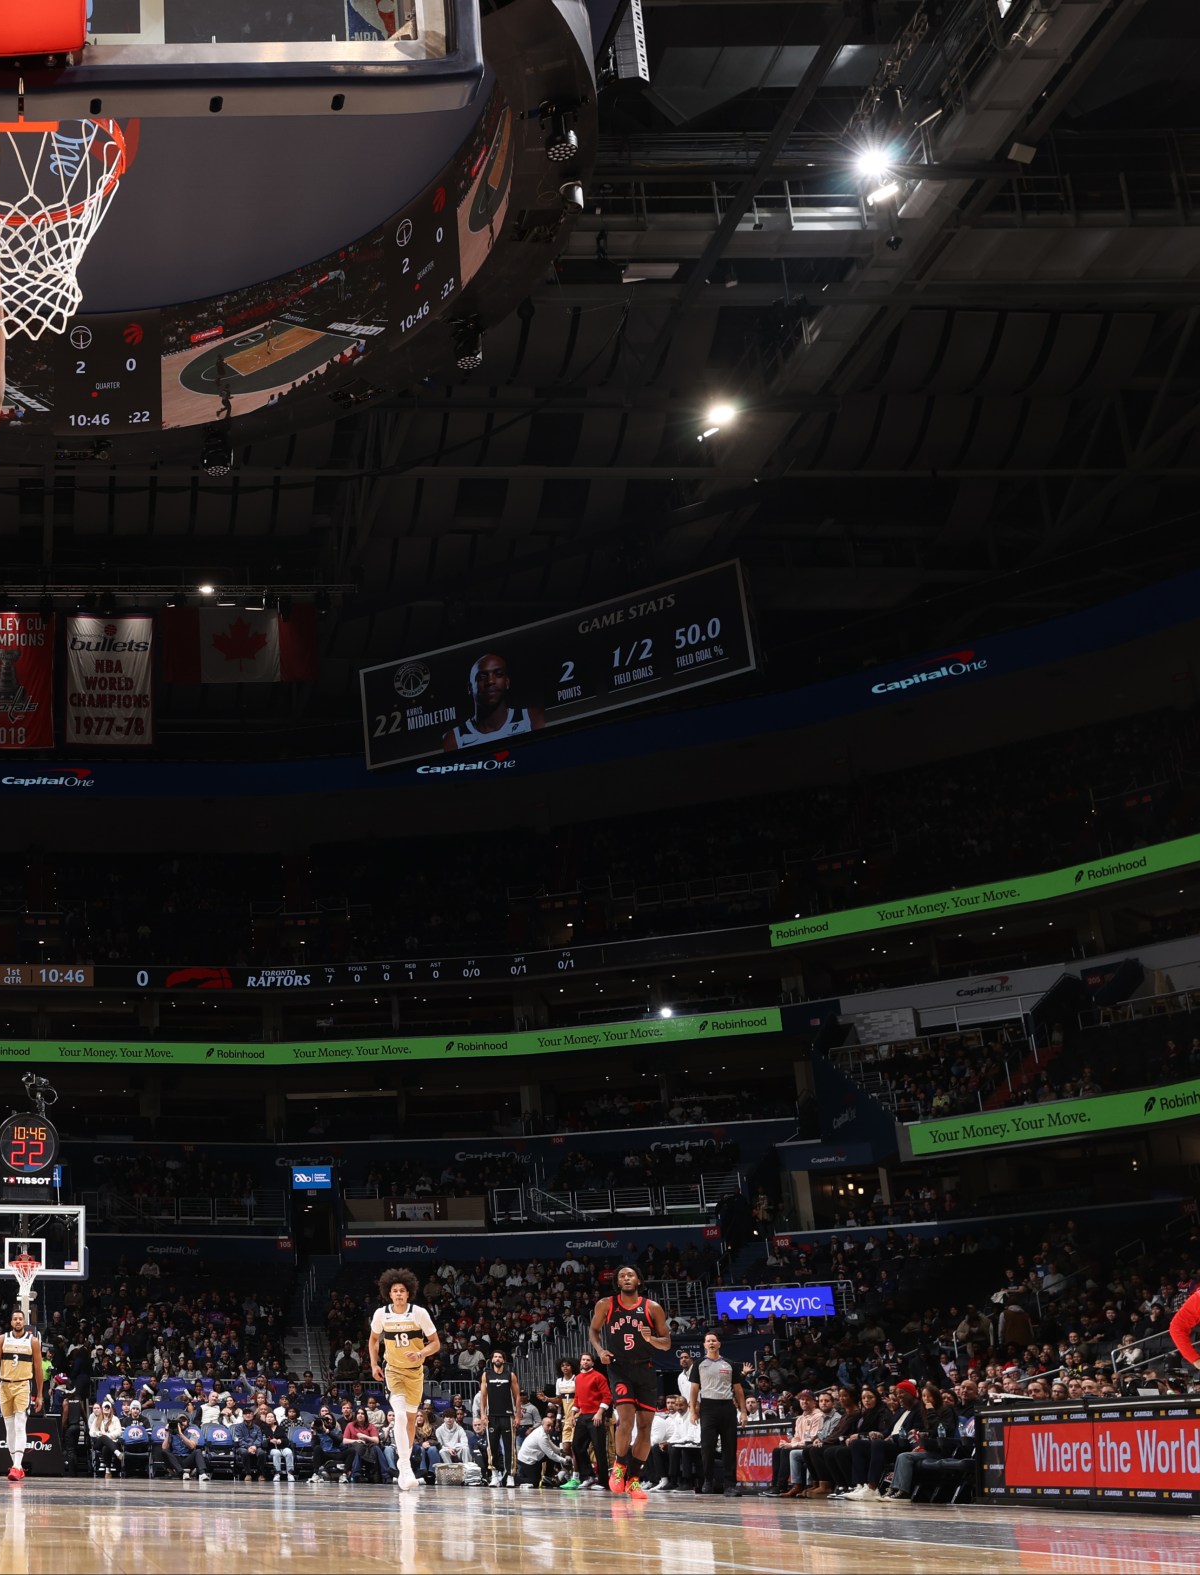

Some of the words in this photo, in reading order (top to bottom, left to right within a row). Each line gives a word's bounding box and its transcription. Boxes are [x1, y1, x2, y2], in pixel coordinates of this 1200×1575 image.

[435, 227, 443, 243] 0
[401, 257, 410, 274] 2
[440, 277, 455, 300] :22
[399, 301, 430, 333] 10:46
[75, 361, 86, 374] 2
[126, 358, 137, 371] 0
[95, 381, 120, 390] QUARTER
[69, 414, 110, 426] 10:46
[128, 411, 150, 423] :22
[578, 610, 625, 634] GAME
[628, 593, 676, 620] STATS
[674, 617, 721, 650] 50.0
[70, 637, 149, 652] bullets
[611, 638, 653, 669] 1/2
[676, 653, 694, 668] FIELD
[695, 648, 712, 663] GOAL
[95, 659, 123, 674] NBA
[558, 660, 576, 684] 2
[85, 676, 133, 691] WORLD
[614, 671, 631, 687] FIELD
[632, 665, 654, 681] GOALS
[69, 693, 150, 709] CHAMPIONS
[557, 685, 582, 702] POINTS
[74, 716, 145, 736] 1977-78
[373, 711, 402, 738] 22
[407, 706, 457, 731] MIDDLETON
[1087, 857, 1147, 881] Robinhood
[877, 907, 906, 922] Your
[907, 900, 950, 919] Money.
[951, 893, 981, 909] Your
[982, 887, 1021, 903] Move.
[776, 922, 829, 940] Robinhood
[6, 967, 20, 976] 1st
[510, 965, 527, 976] 0/1
[557, 959, 575, 971] 0/1
[3, 976, 22, 984] QTR
[40, 969, 85, 983] 10:46
[136, 970, 148, 986] 0
[246, 974, 311, 987] RAPTORS
[261, 969, 296, 977] TORONTO
[326, 975, 333, 983] 7
[354, 974, 361, 983] 0
[383, 972, 390, 981] 0
[408, 971, 414, 980] 1
[433, 970, 440, 979] 0
[462, 968, 481, 978] 0/0
[711, 1017, 767, 1031] Robinhood
[538, 1036, 563, 1047] Your
[564, 1033, 601, 1046] Money.
[603, 1030, 629, 1041] Your
[630, 1027, 663, 1039] Move.
[58, 1047, 81, 1057] Your
[83, 1047, 118, 1059] Money.
[119, 1048, 143, 1058] Your
[144, 1048, 174, 1058] Move.
[217, 1049, 265, 1059] Robinhood
[293, 1049, 314, 1059] Your
[314, 1047, 353, 1059] Money.
[355, 1047, 381, 1056] Your
[382, 1045, 412, 1055] Move.
[457, 1042, 508, 1051] Robinhood
[14, 1126, 47, 1140] 10:46
[929, 1128, 960, 1143] Your
[962, 1121, 1010, 1141] Money.
[1012, 1117, 1045, 1132] Your
[1047, 1111, 1091, 1127] Move.
[10, 1141, 44, 1166] 22
[16, 1177, 51, 1185] TISSOT
[758, 1294, 821, 1313] ZKsync
[394, 1333, 410, 1348] 18
[624, 1334, 635, 1350] 5
[12, 1354, 19, 1367] 3
[1031, 1432, 1093, 1473] Where
[1098, 1430, 1131, 1473] the
[1136, 1428, 1200, 1474] World
